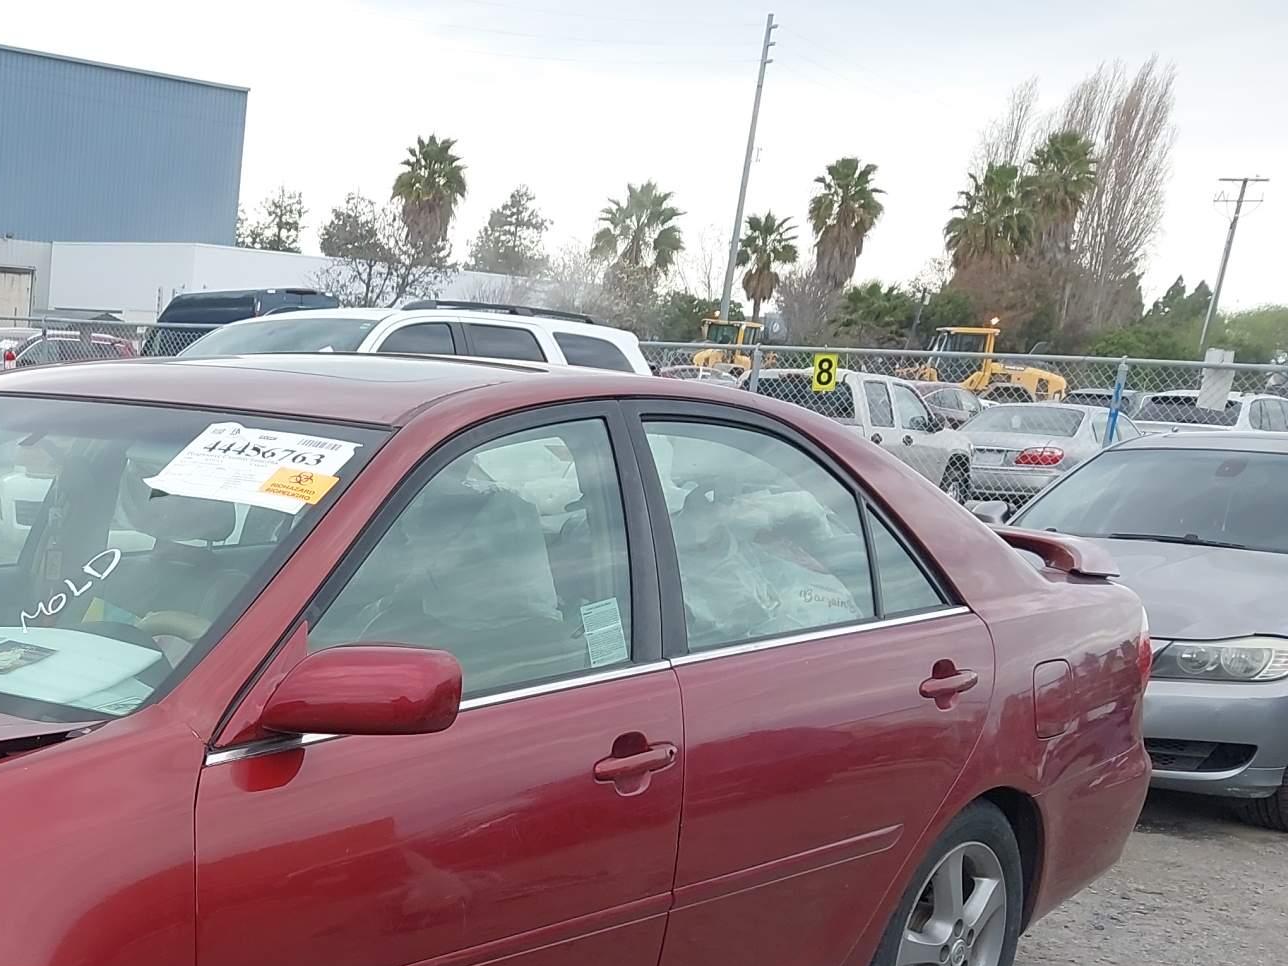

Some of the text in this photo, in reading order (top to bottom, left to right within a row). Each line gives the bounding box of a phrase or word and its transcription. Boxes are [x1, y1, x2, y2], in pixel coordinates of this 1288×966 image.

[817, 358, 833, 385] 8
[204, 440, 326, 466] 44456763
[270, 482, 316, 496] BIOHAZARD
[20, 548, 122, 634] MOLD
